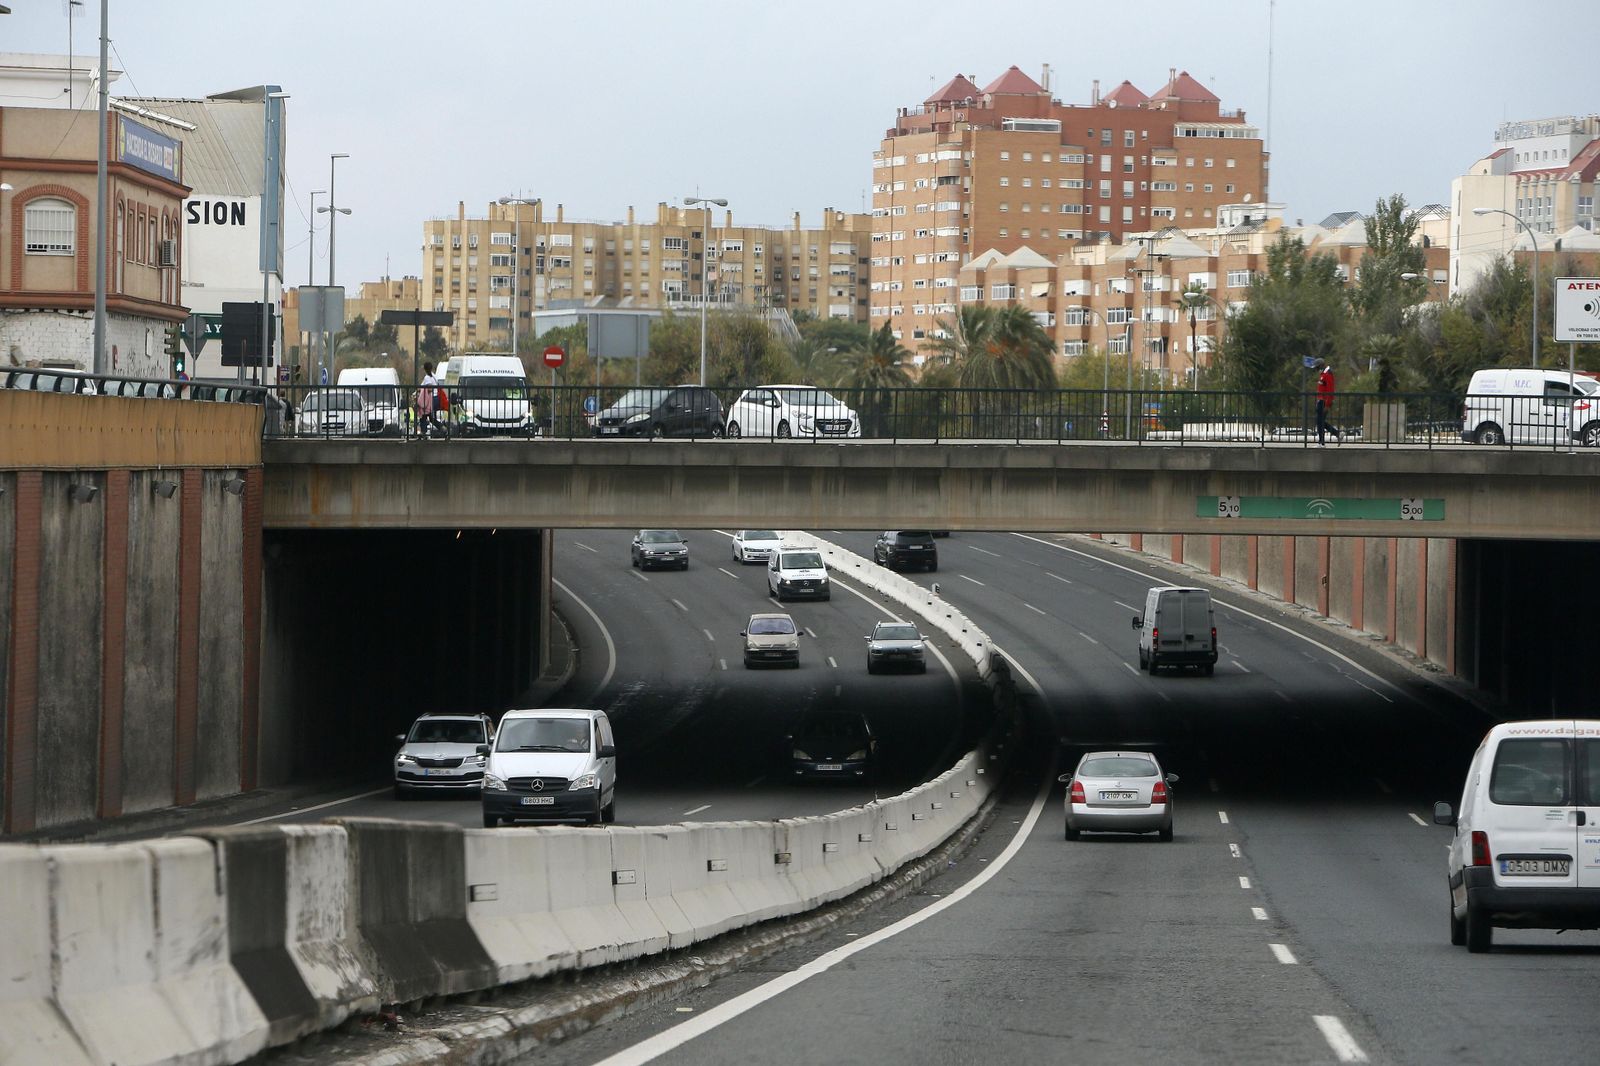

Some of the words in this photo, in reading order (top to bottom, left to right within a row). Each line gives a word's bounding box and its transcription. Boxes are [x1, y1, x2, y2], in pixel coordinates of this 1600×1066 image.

[186, 200, 246, 226] SION
[1508, 861, 1538, 873] 0503
[1543, 861, 1567, 873] DMX
